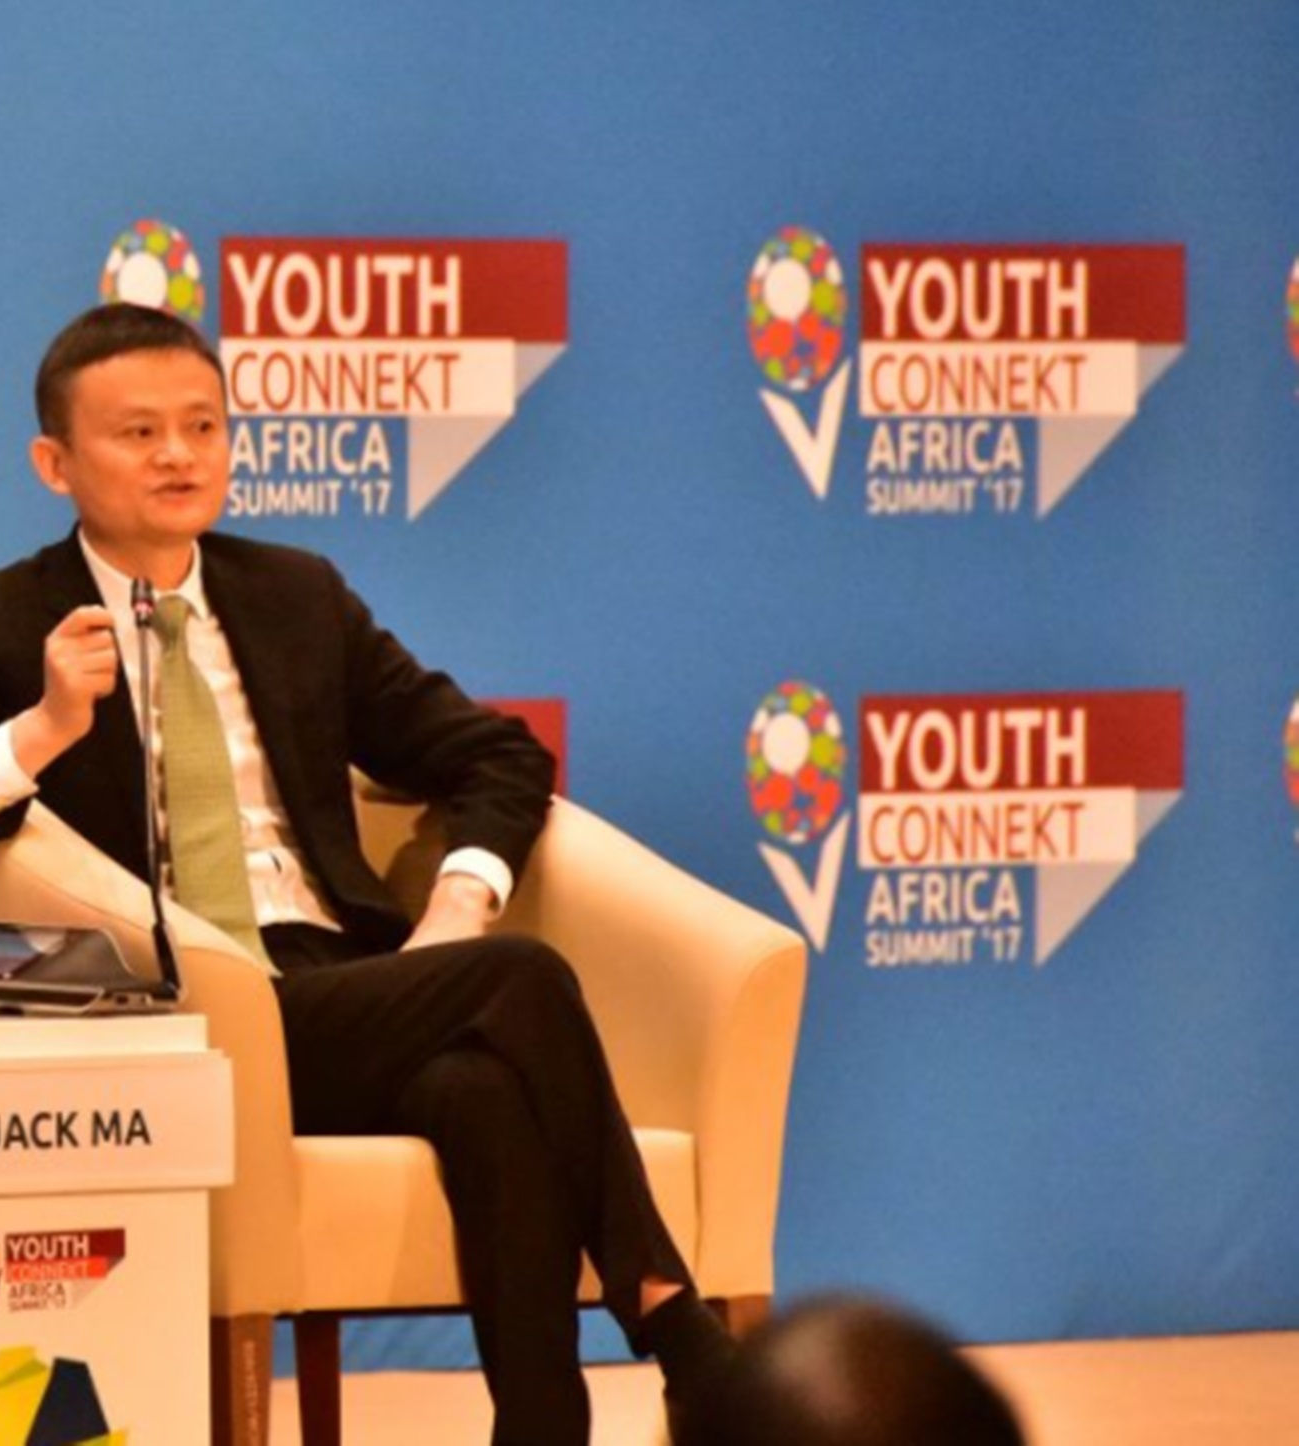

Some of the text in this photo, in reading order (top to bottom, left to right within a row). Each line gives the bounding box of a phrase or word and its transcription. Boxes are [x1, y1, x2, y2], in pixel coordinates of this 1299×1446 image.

[228, 254, 461, 337] YOUTH
[868, 259, 1089, 338] YOUTH
[230, 351, 461, 412] CONNEKT
[869, 354, 1087, 412] CONNEKT
[229, 421, 391, 475] AFRICA
[867, 421, 1024, 474] AFRICA
[228, 480, 391, 517] SUMMIT '17
[867, 477, 1024, 514] SUMMIT '17
[866, 709, 1087, 791] YOUTH
[868, 802, 1085, 864] CONNEKT
[866, 871, 1021, 925] AFRICA
[866, 926, 1022, 967] SUMMIT '17
[91, 1109, 151, 1147] MA
[9, 1234, 90, 1261] YOUTH
[8, 1281, 66, 1301] AFRICA
